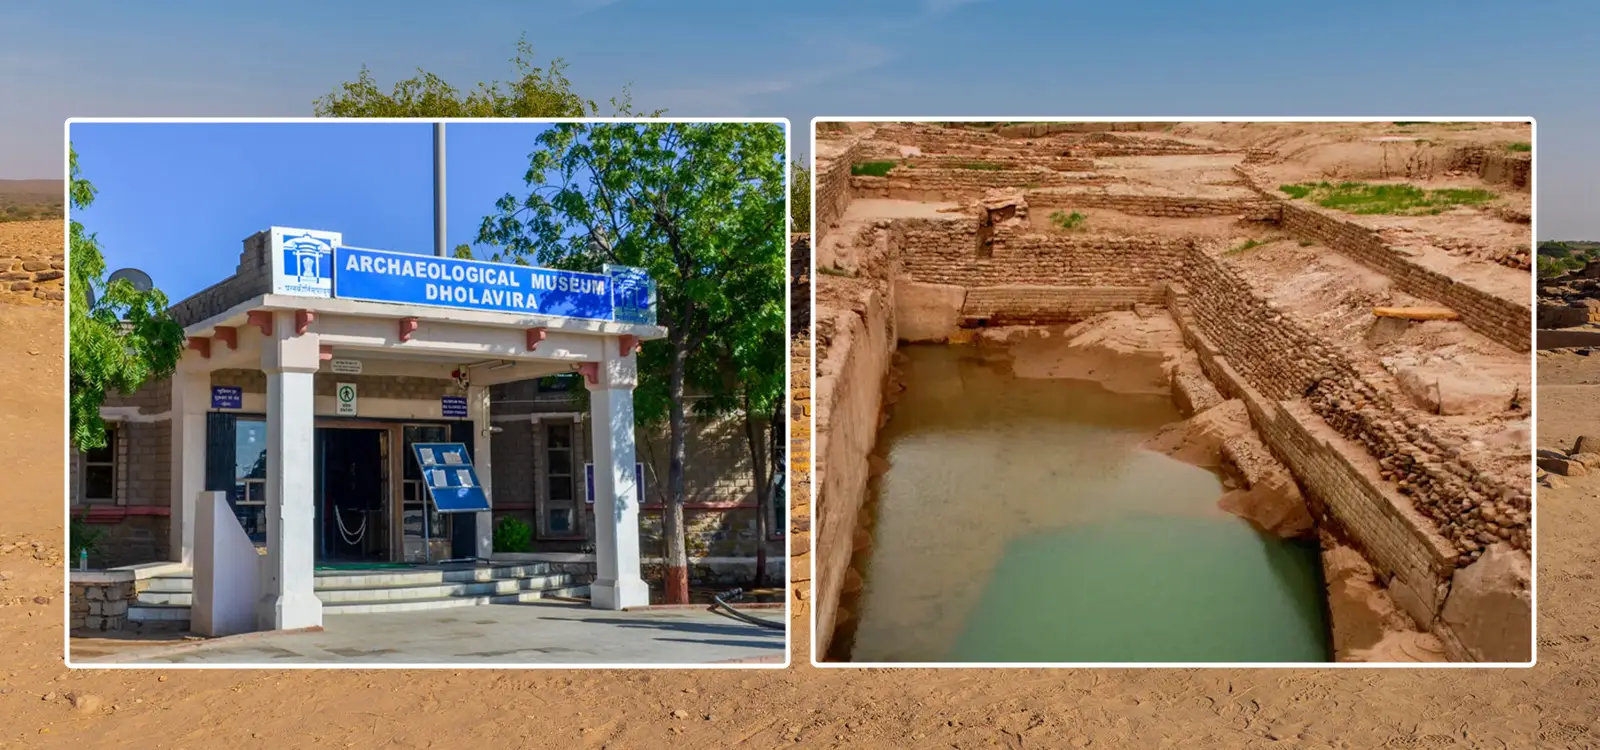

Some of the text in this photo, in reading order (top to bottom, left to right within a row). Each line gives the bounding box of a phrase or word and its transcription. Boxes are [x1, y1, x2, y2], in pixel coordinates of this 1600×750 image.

[346, 254, 605, 296] ARCHAEOLOGICAL MUSEUM
[426, 284, 538, 309] DHOLAVIRA
